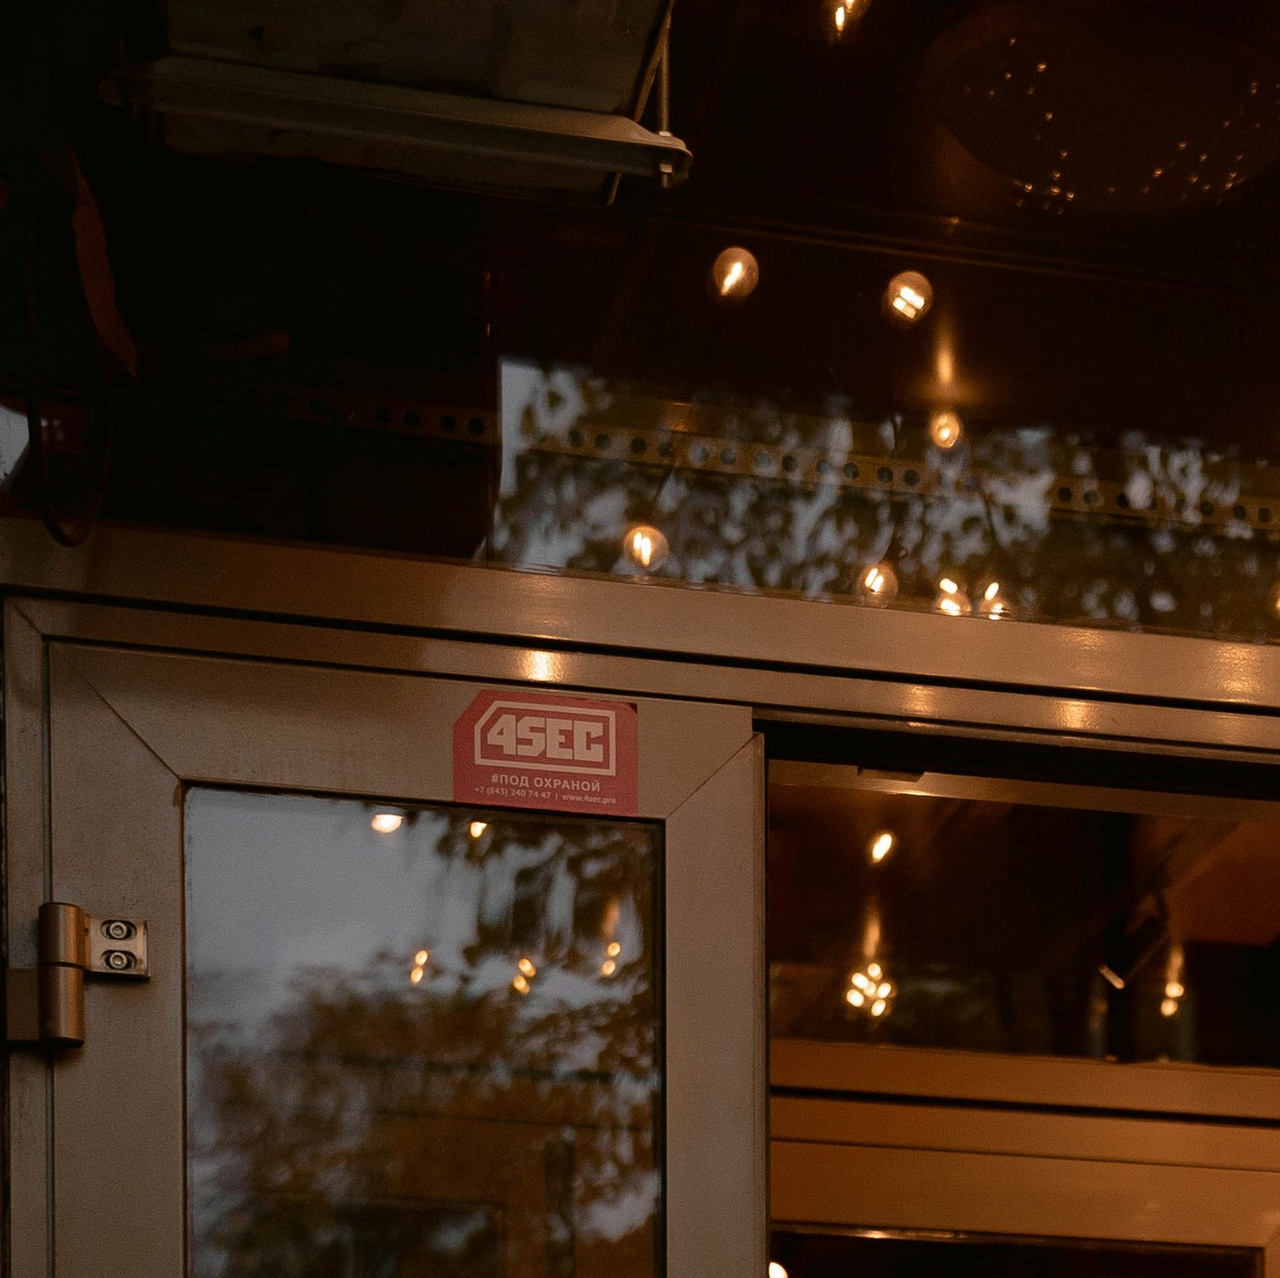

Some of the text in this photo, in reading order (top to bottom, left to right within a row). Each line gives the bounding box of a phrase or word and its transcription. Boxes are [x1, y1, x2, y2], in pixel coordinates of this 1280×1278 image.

[487, 714, 604, 763] 4SEC
[491, 773, 600, 792] #ПОД ОХРАНОЙ
